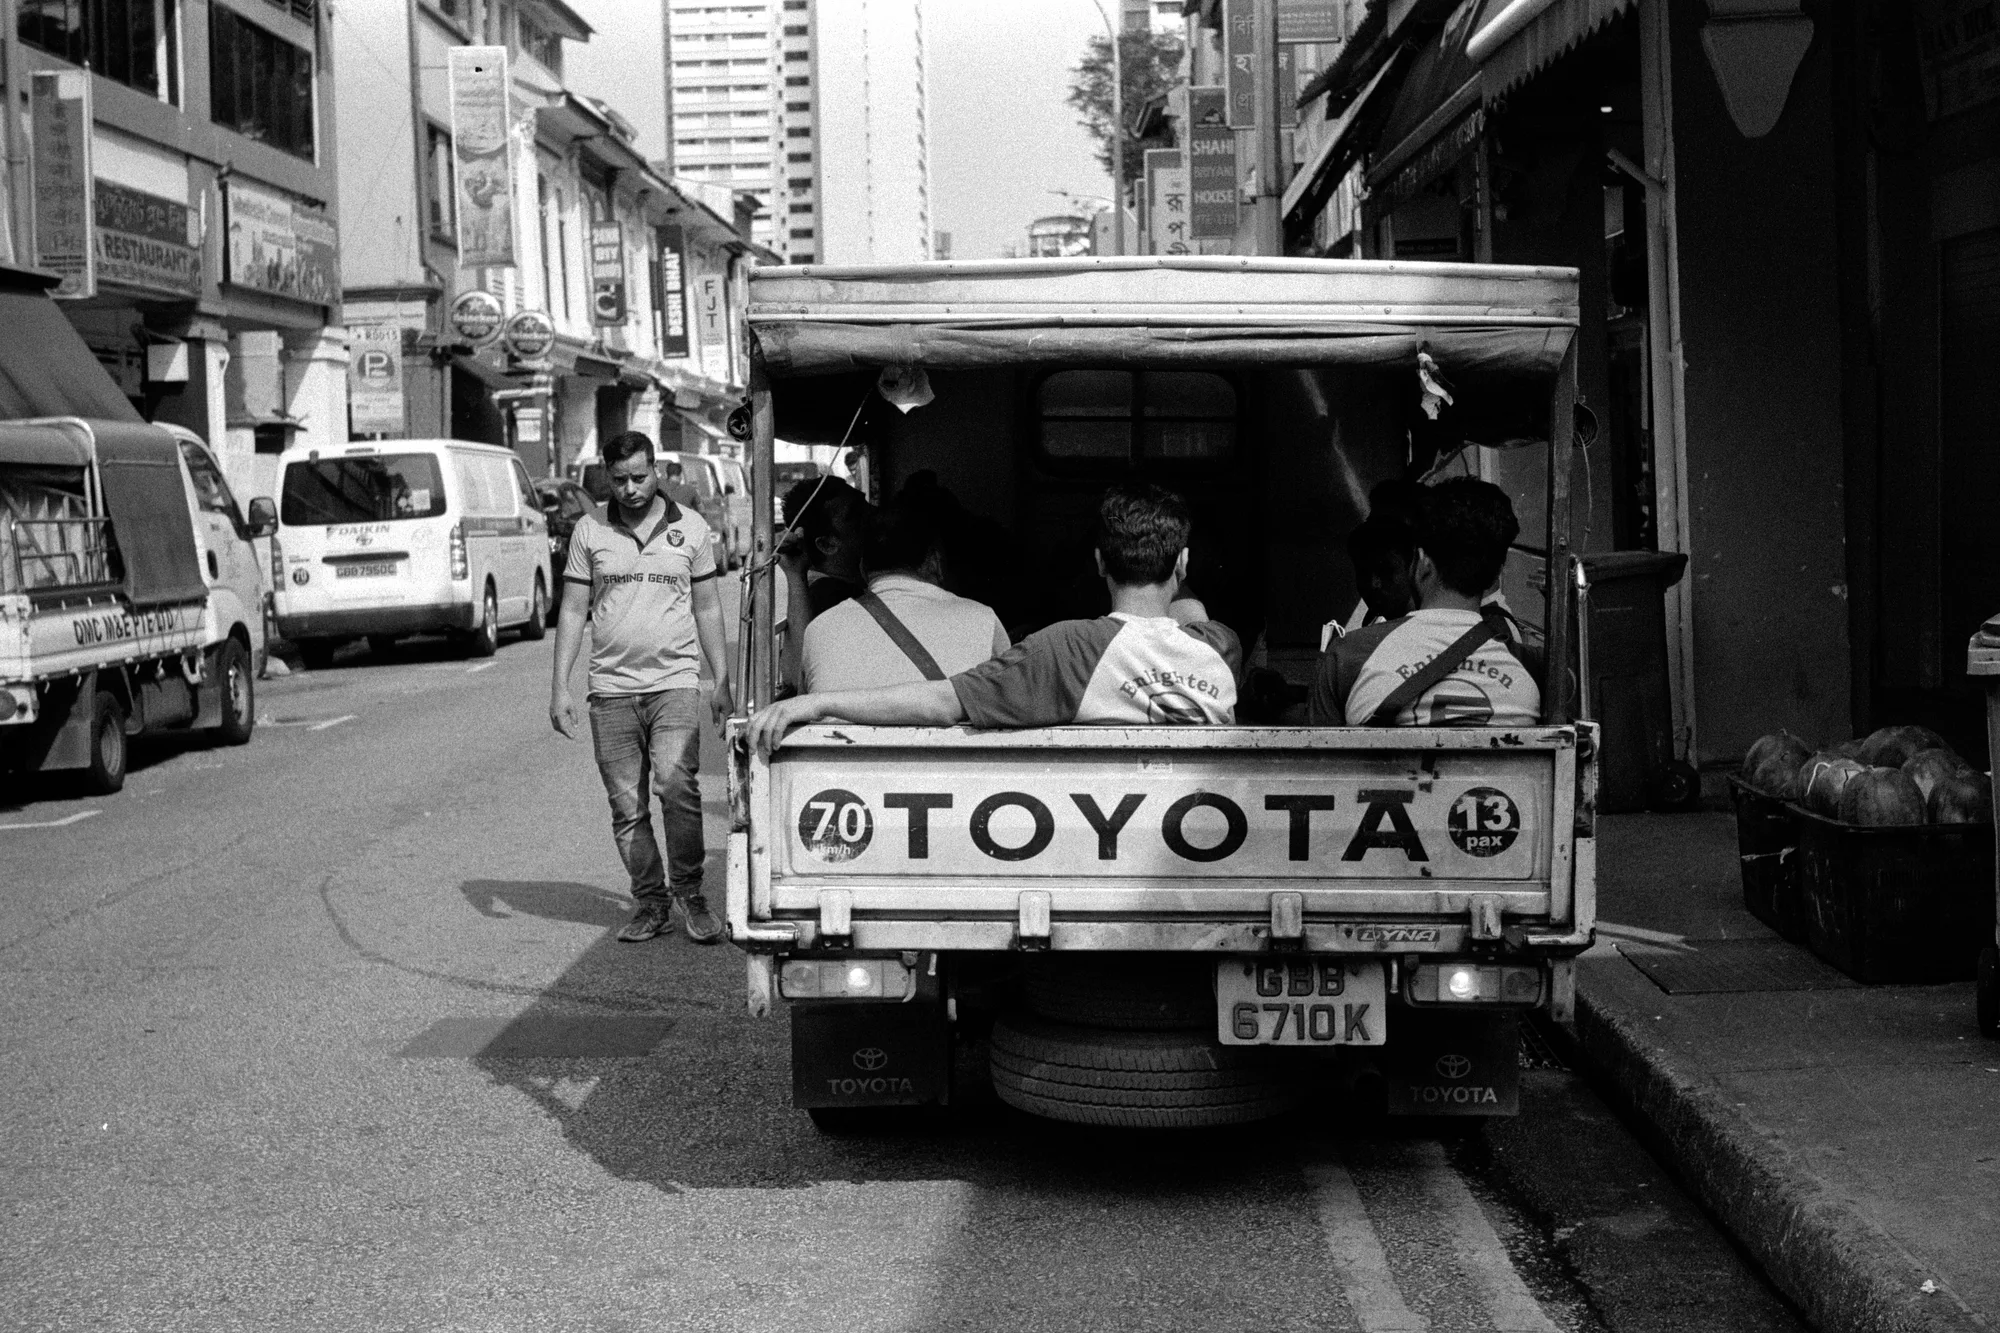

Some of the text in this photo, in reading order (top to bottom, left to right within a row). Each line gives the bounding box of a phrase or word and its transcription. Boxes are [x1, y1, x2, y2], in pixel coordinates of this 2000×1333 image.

[1194, 190, 1235, 203] HOUSE
[666, 292, 684, 336] DESHI
[339, 525, 390, 535] DAIKIN
[603, 573, 678, 585] GAMING GEAR
[1120, 668, 1220, 699] Enlighten
[809, 802, 866, 842] 70
[1457, 796, 1511, 830] 13
[884, 790, 1429, 862] TOYOTA
[1467, 836, 1502, 850] pax
[1360, 929, 1437, 941] DYNA
[1256, 962, 1345, 997] GBB
[1232, 1002, 1371, 1042] 6710K
[827, 1078, 913, 1095] TOYOTA
[1410, 1086, 1497, 1103] TOYOTA
